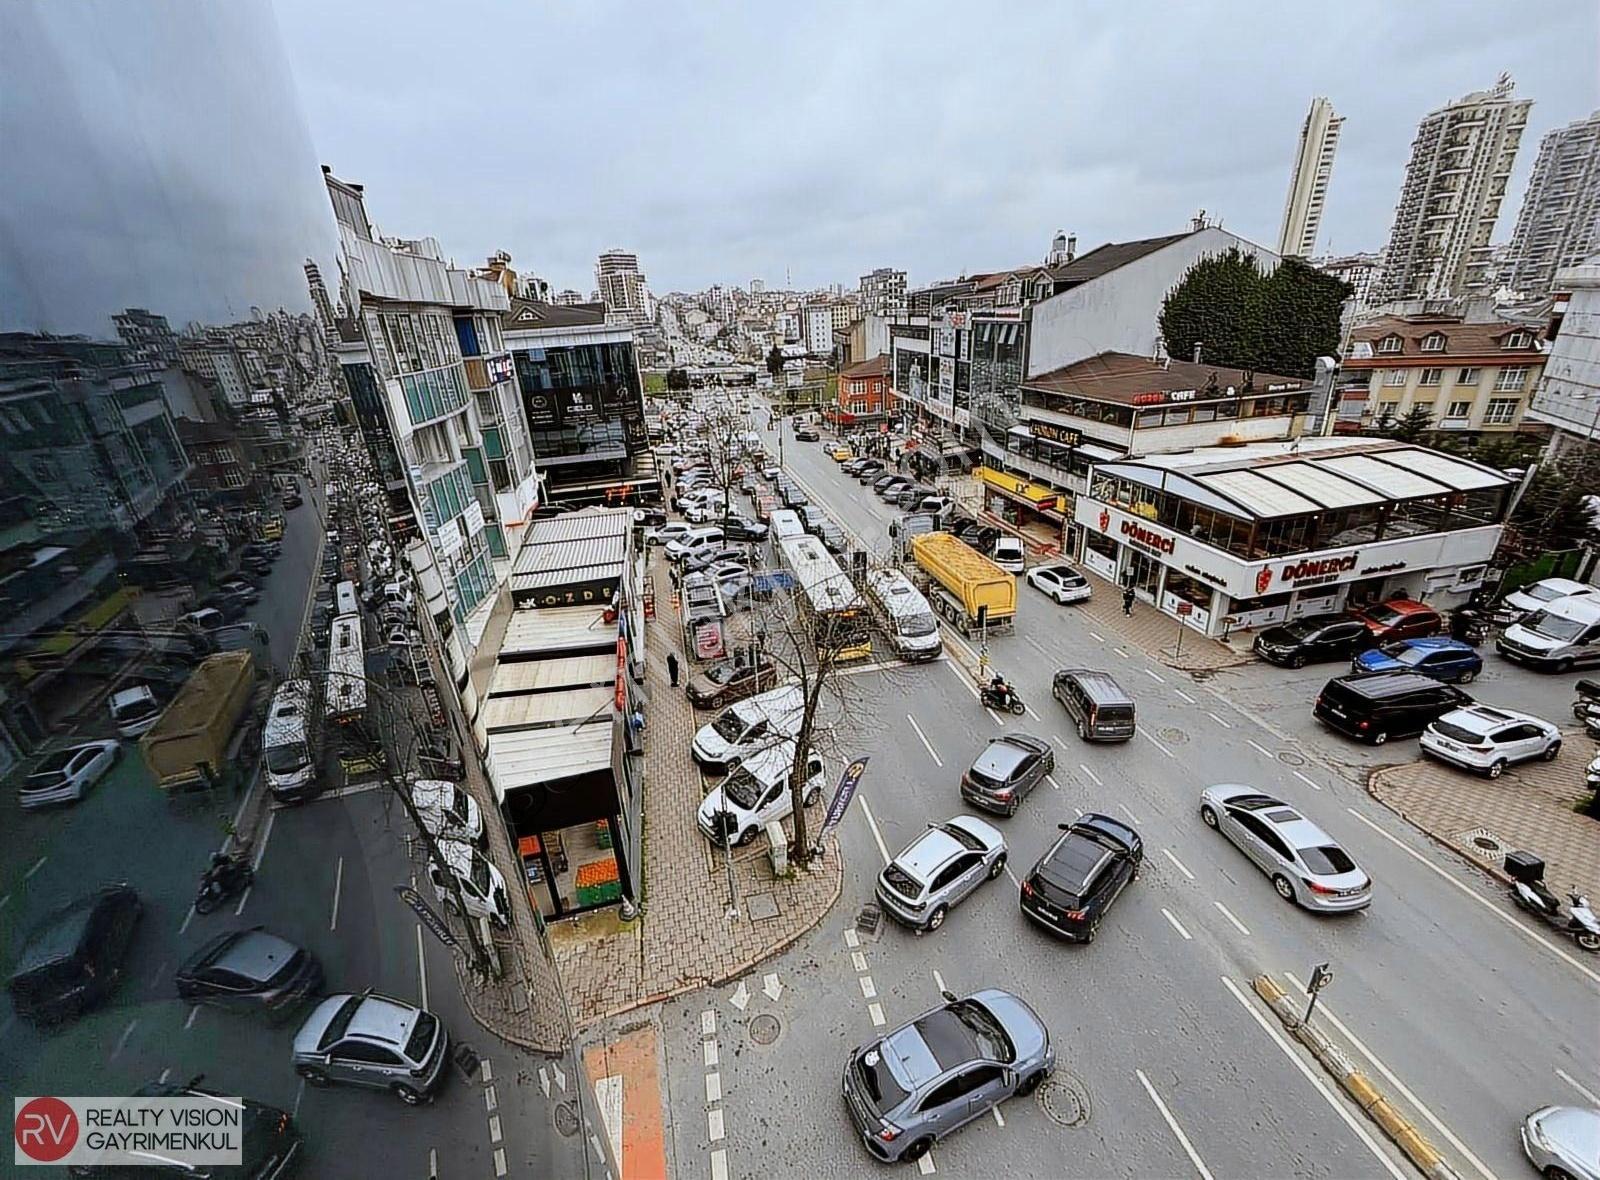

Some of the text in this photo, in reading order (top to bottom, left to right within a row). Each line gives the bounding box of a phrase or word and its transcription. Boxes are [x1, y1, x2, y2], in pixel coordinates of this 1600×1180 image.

[1171, 389, 1196, 401] CAFE
[1060, 429, 1080, 446] CAFE
[1120, 520, 1176, 555] DÖNERCİ
[1281, 551, 1359, 581] DÖNERCİ
